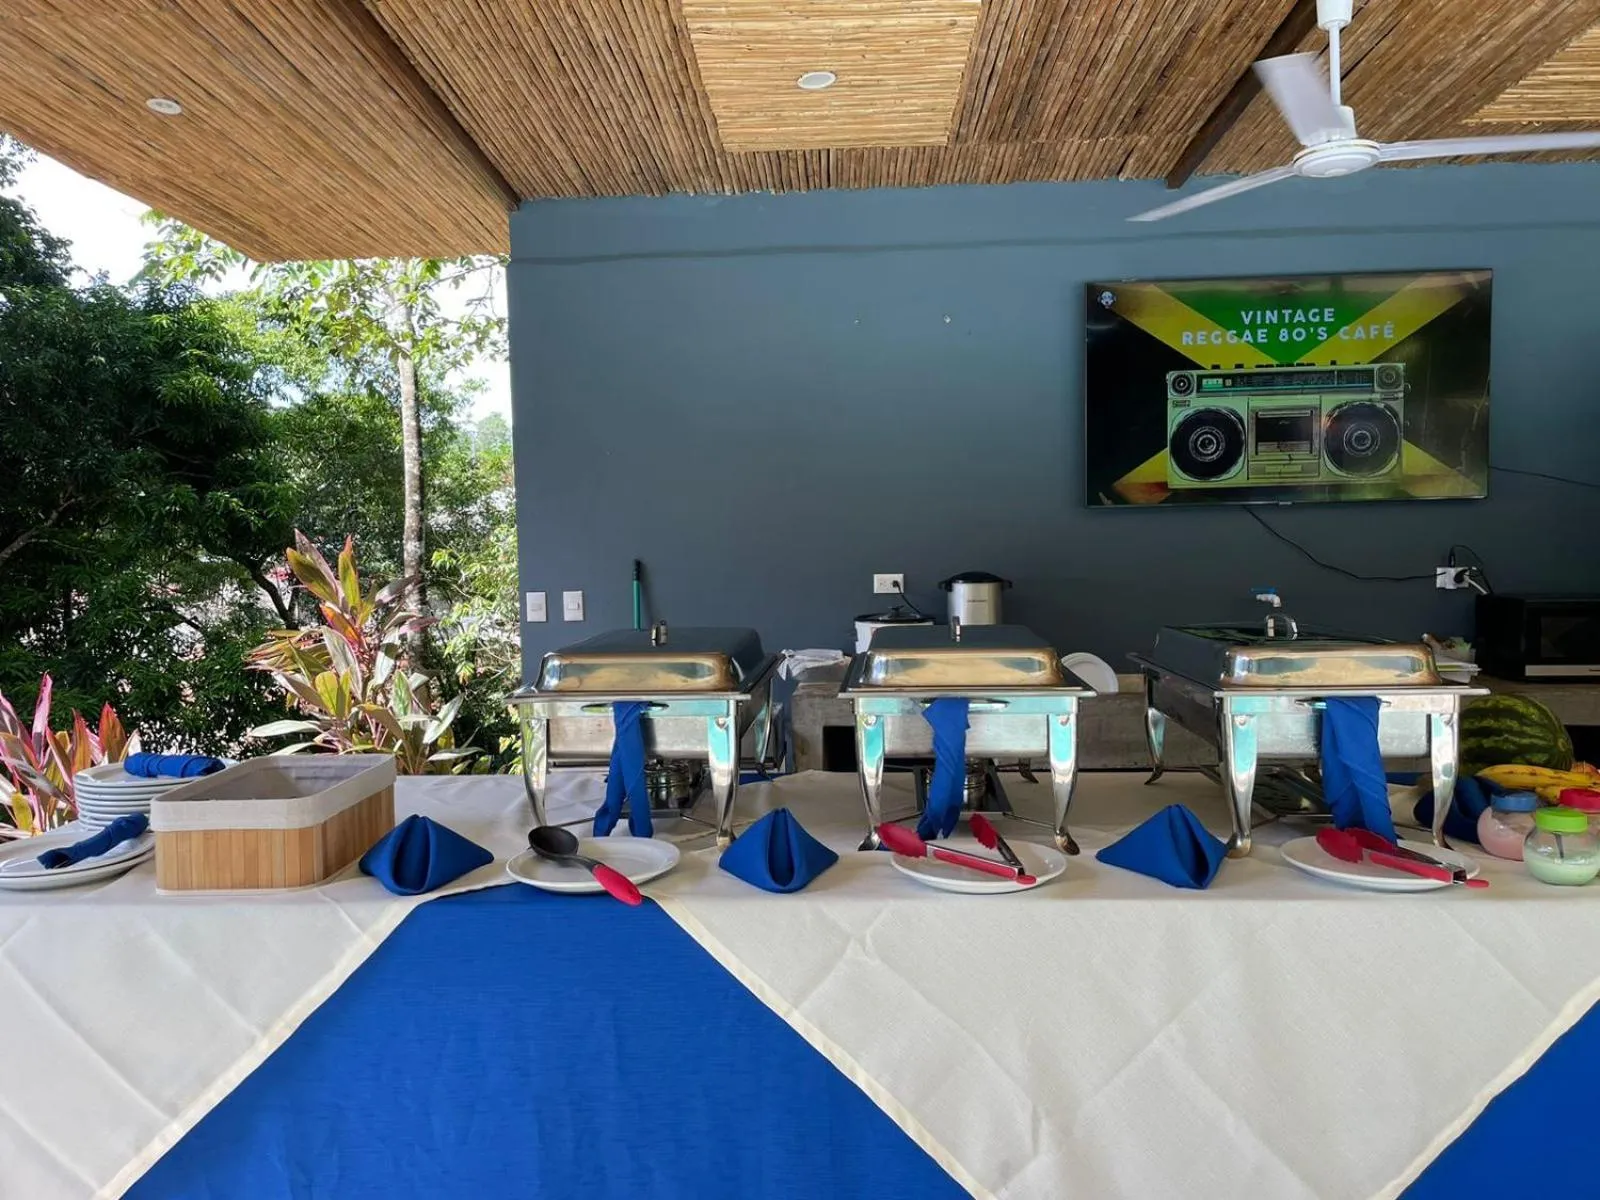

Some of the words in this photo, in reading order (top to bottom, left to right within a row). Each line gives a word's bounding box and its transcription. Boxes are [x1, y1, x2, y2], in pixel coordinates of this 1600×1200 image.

[1240, 307, 1336, 325] VINTAGE
[1182, 328, 1269, 346] REGGAE
[1278, 326, 1328, 342] 80'S
[1338, 321, 1395, 340] CAFÉ
